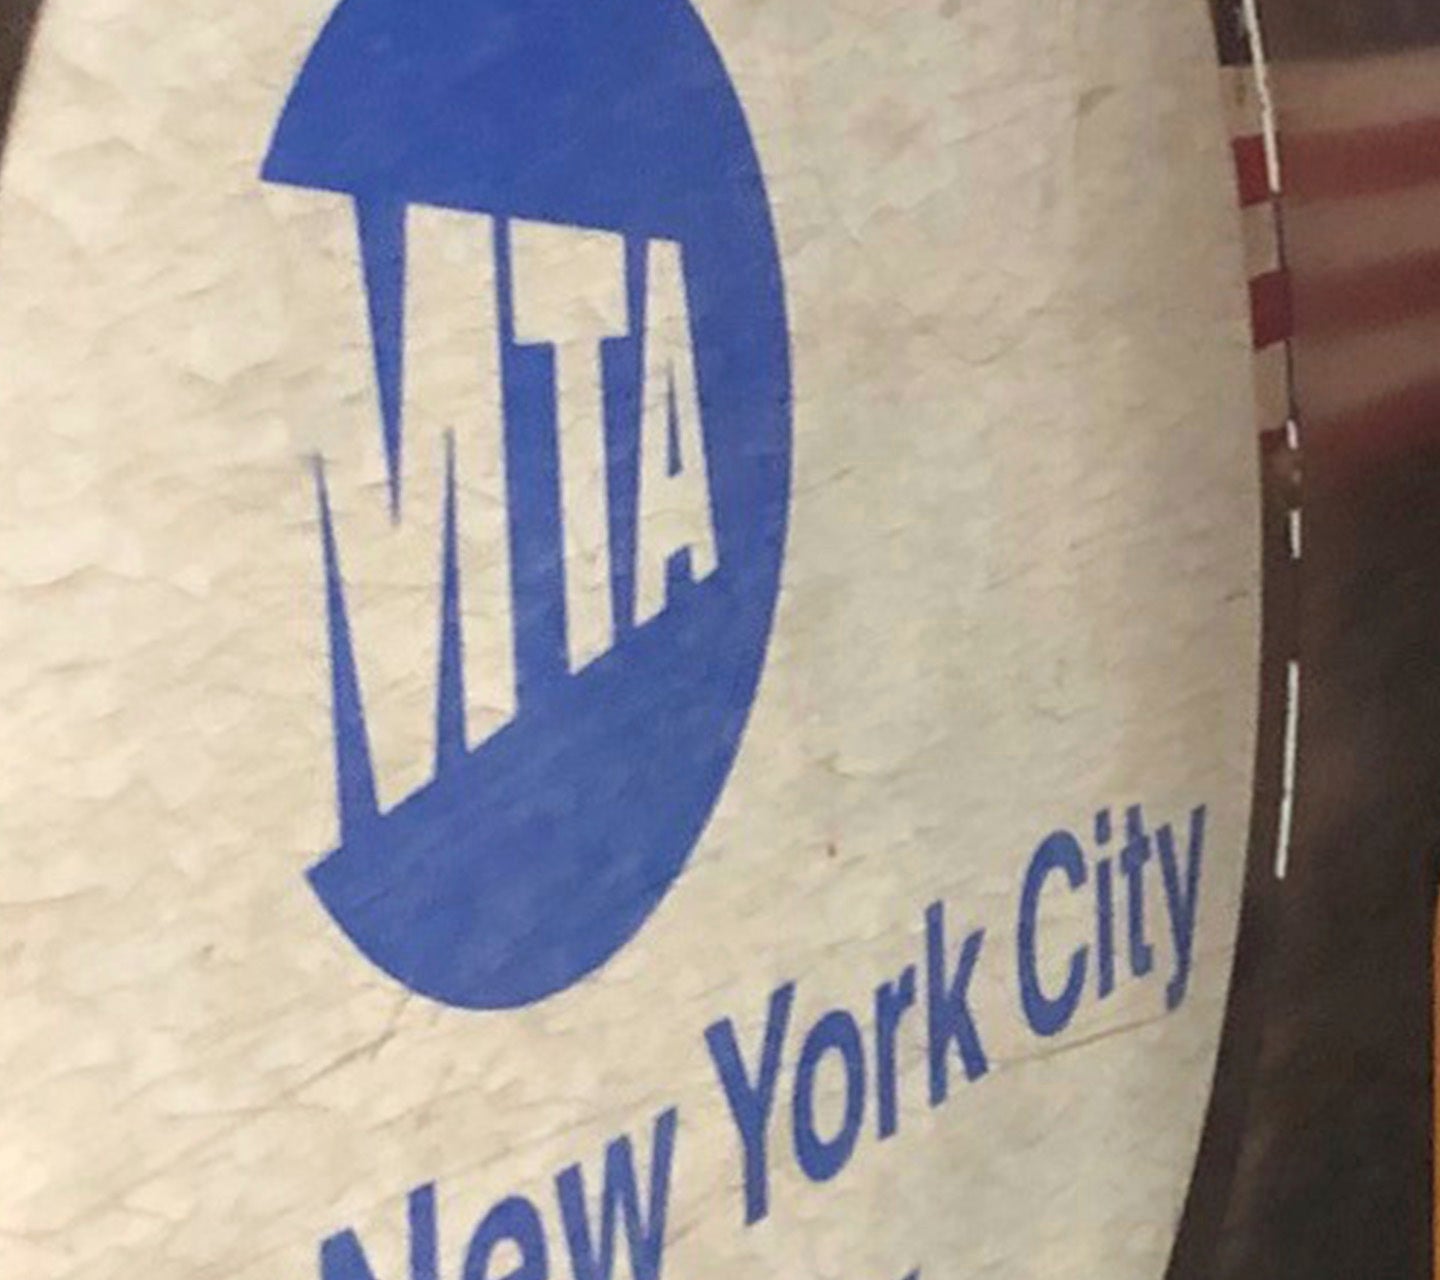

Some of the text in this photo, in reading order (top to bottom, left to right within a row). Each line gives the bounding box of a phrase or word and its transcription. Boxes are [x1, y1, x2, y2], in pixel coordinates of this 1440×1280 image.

[260, 182, 718, 842] MTA
[704, 902, 990, 1226] York
[1016, 804, 1207, 1037] City
